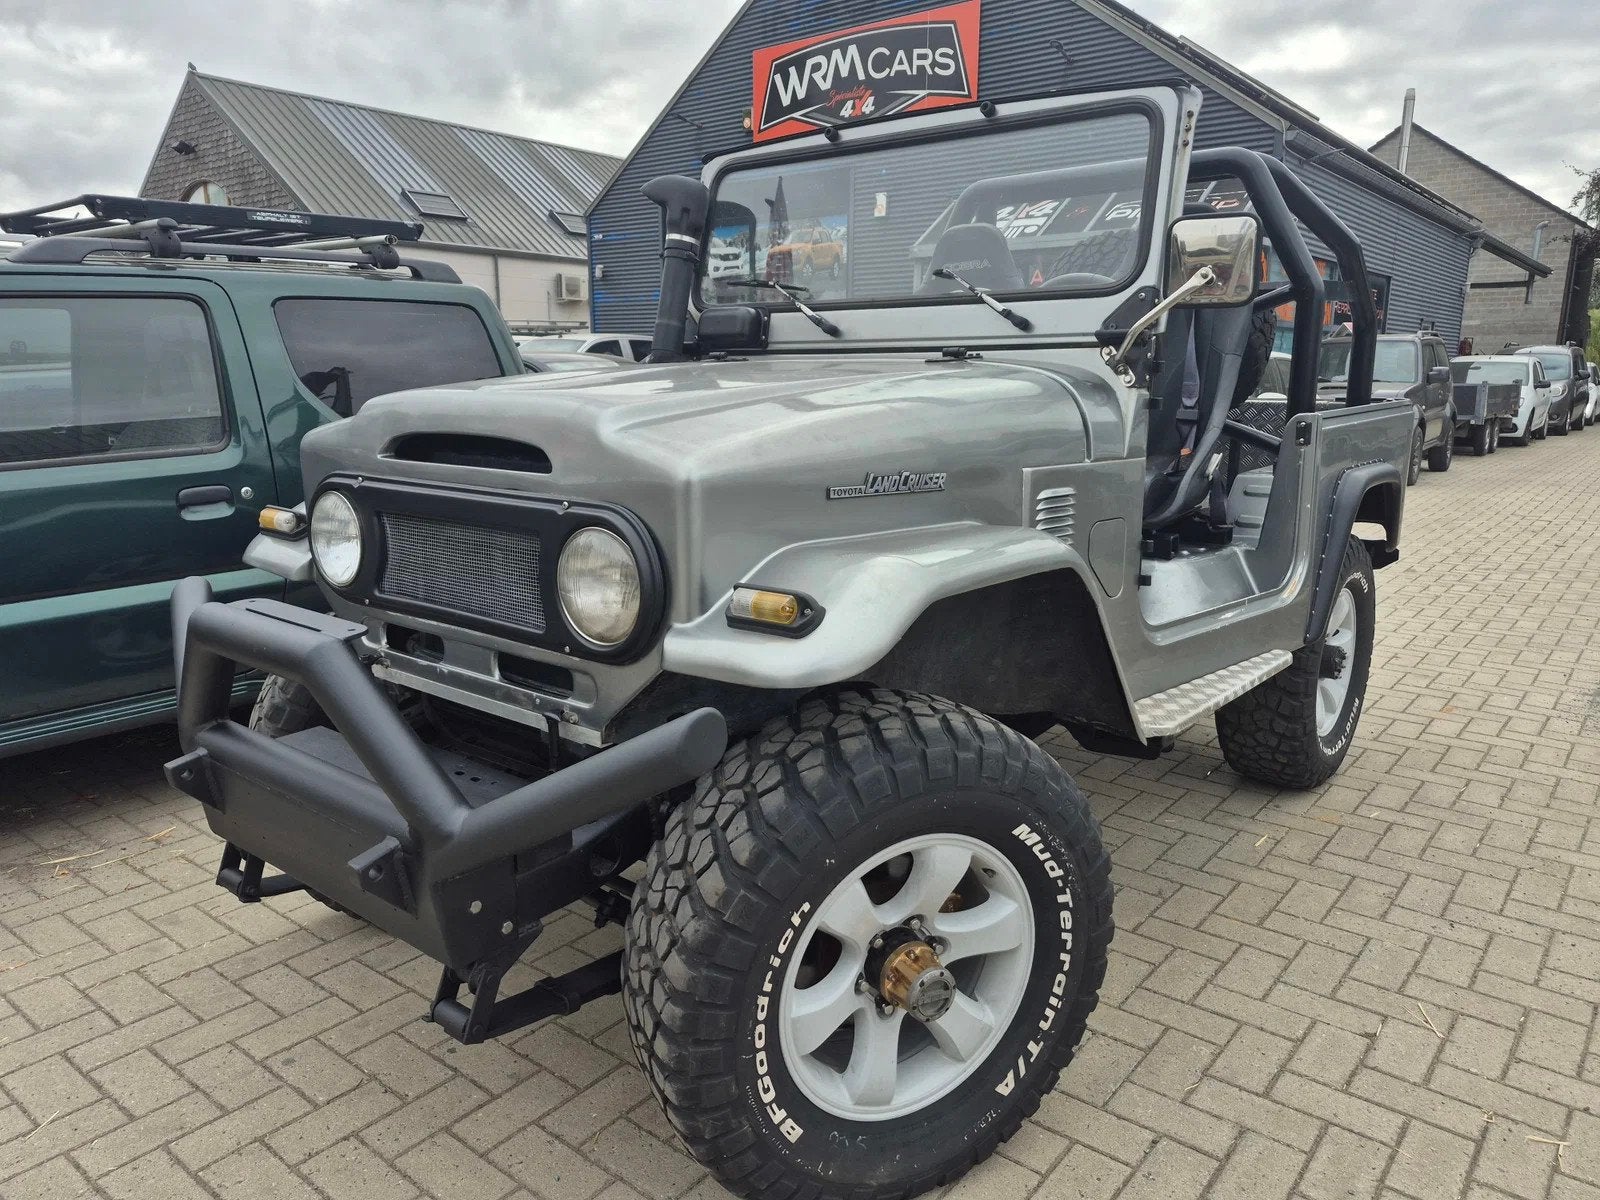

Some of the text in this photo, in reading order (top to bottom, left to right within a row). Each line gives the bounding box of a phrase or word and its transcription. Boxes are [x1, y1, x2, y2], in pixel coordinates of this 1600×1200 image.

[774, 44, 956, 107] WRM CARS
[831, 486, 865, 497] TOYOTA
[1011, 823, 1073, 1031] Mud-Terrain
[754, 901, 811, 1143] BFGoodrich
[994, 1040, 1044, 1097] T/A
